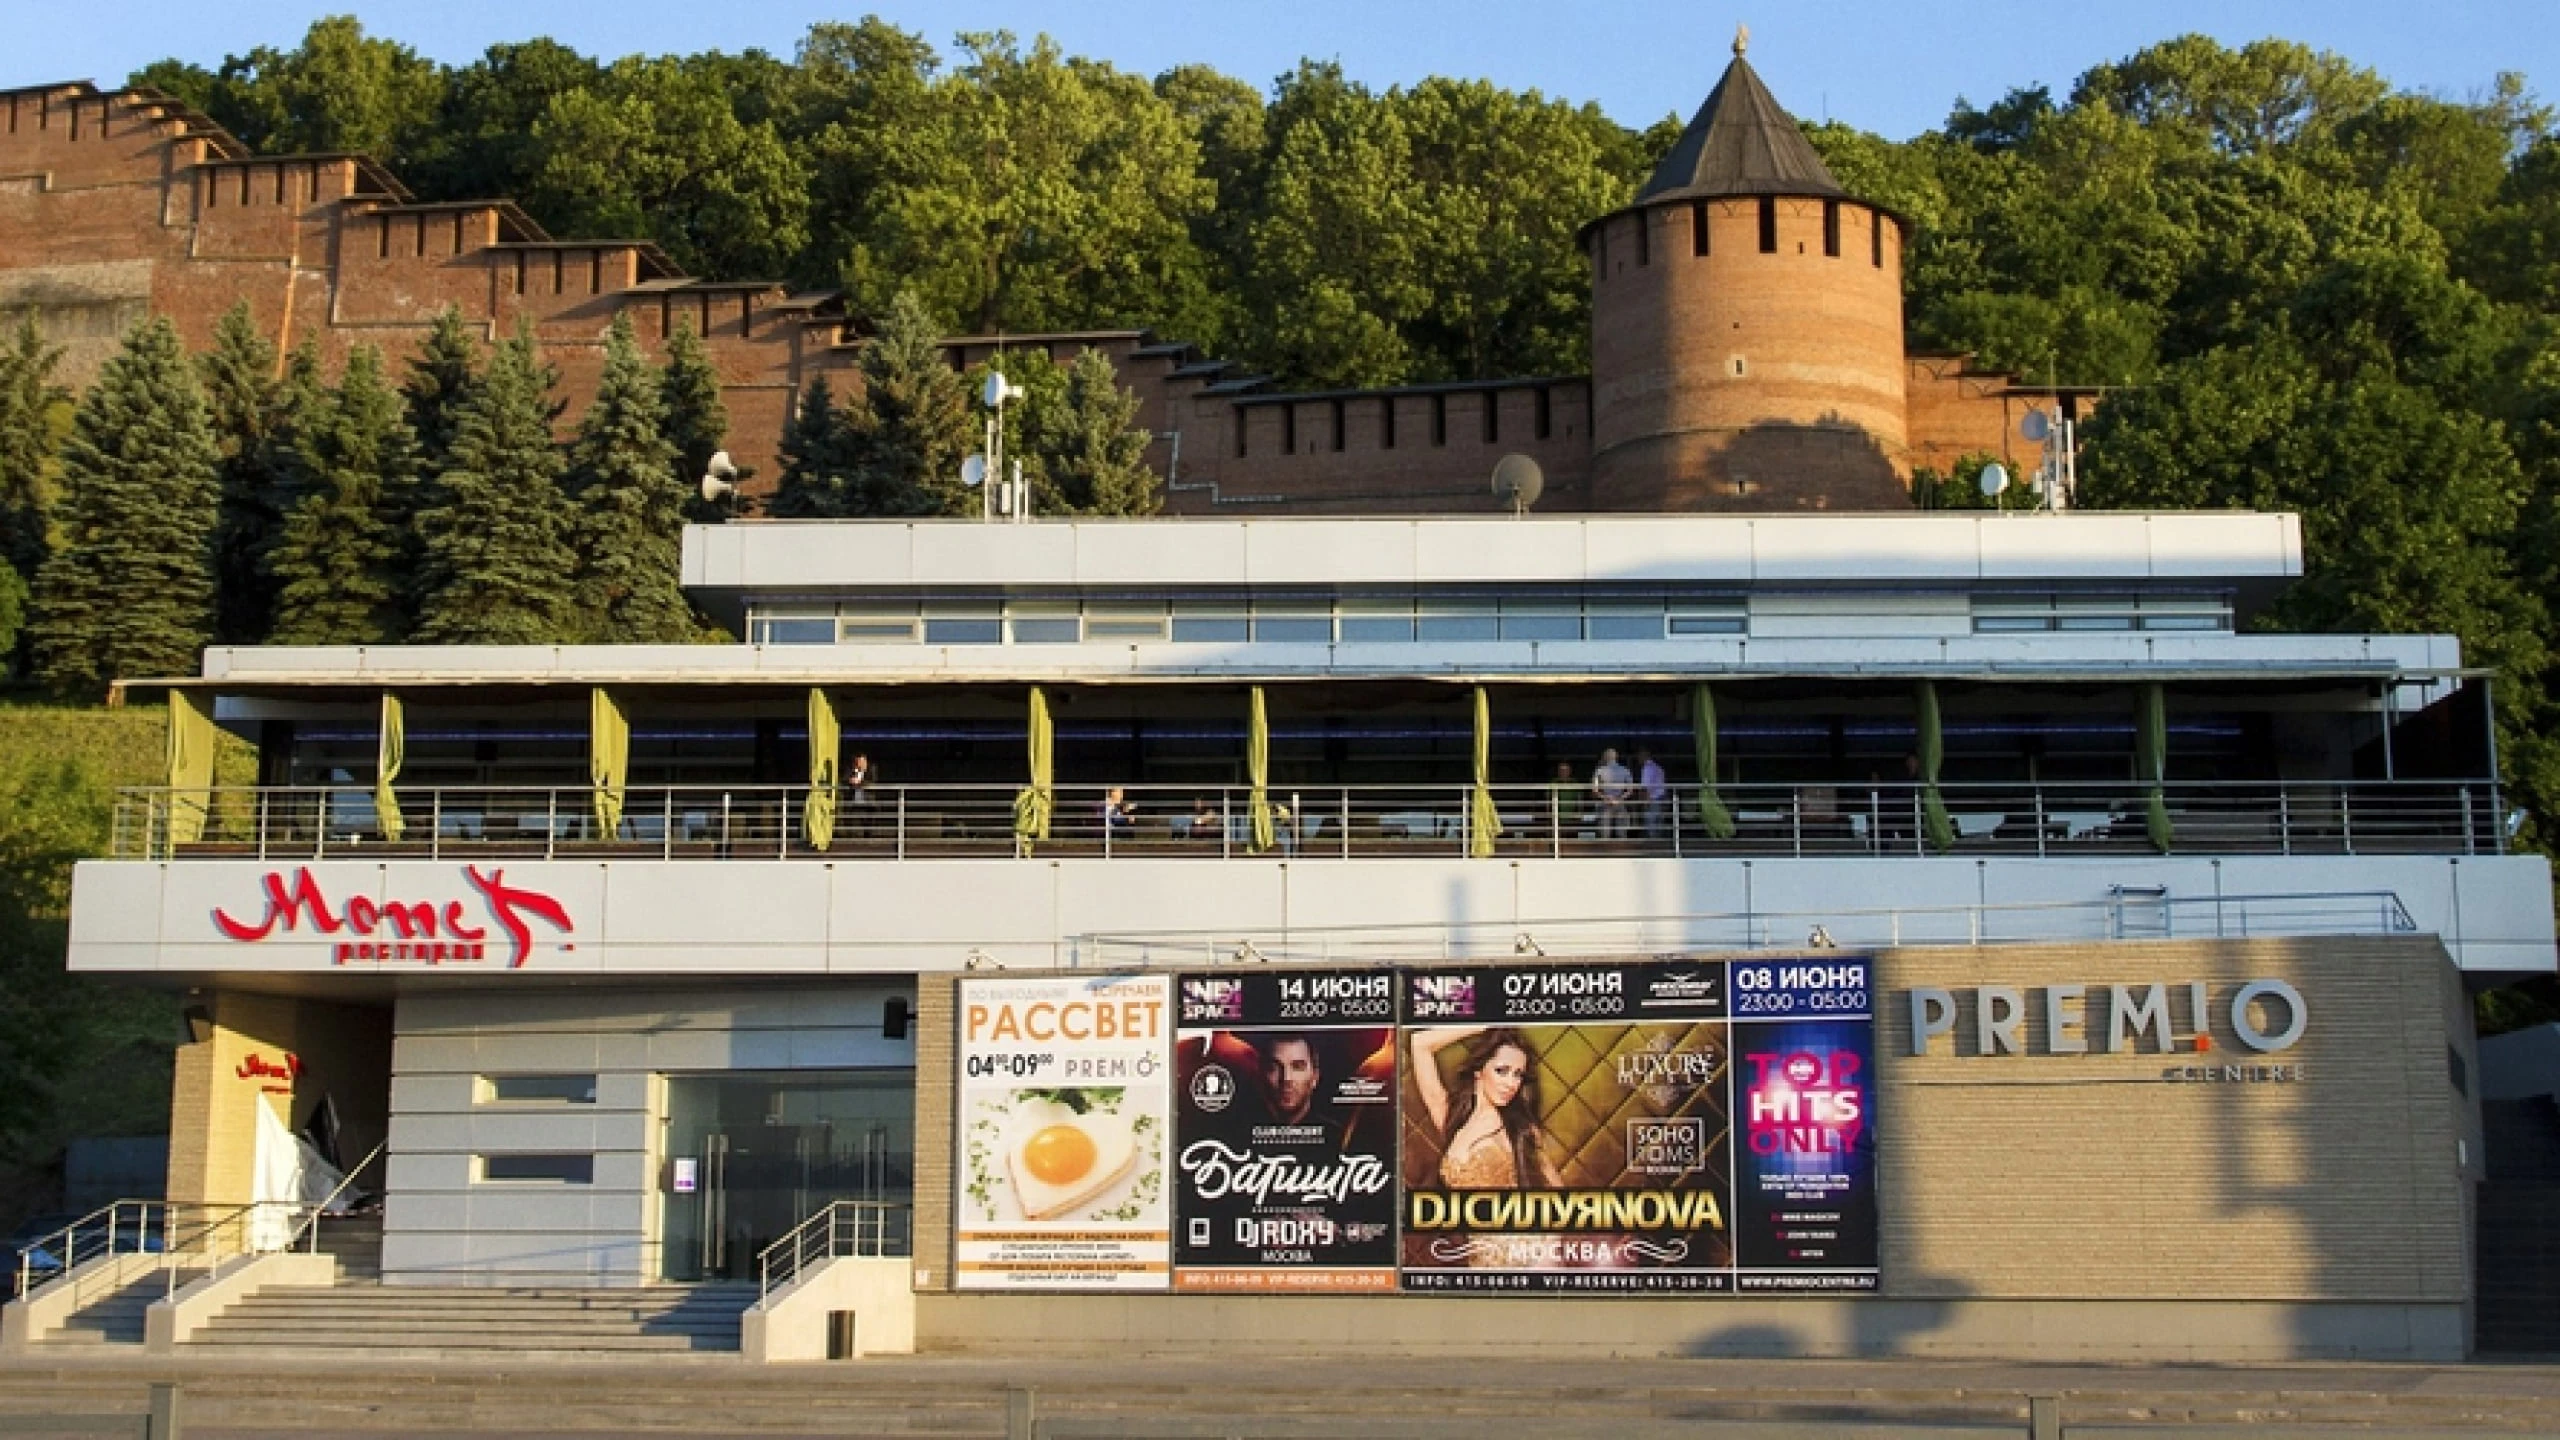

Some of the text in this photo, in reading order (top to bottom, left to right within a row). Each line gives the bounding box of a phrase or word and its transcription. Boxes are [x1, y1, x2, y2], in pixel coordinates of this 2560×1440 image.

[1279, 976, 1390, 1000] 14 ИЮНЯ
[1504, 971, 1623, 996] 07 ИЮНЯ
[1737, 965, 1865, 990] 08 ИЮНЯ
[1280, 1001, 1328, 1017] 23:00
[1341, 999, 1391, 1016] 05:00
[1505, 998, 1556, 1014] 23:00
[1571, 996, 1625, 1013] 05:00
[1739, 993, 1795, 1012] 23:00
[1808, 990, 1867, 1011] 05:00
[967, 1002, 1163, 1041] РАССВЕТ
[1745, 1049, 1861, 1088] TOP
[1752, 1090, 1861, 1122] HITS
[1637, 1125, 1695, 1145] SOHO
[1748, 1126, 1862, 1156] ONLY
[1180, 1140, 1391, 1204] Батишта
[1508, 1241, 1612, 1262] МОСКВА
